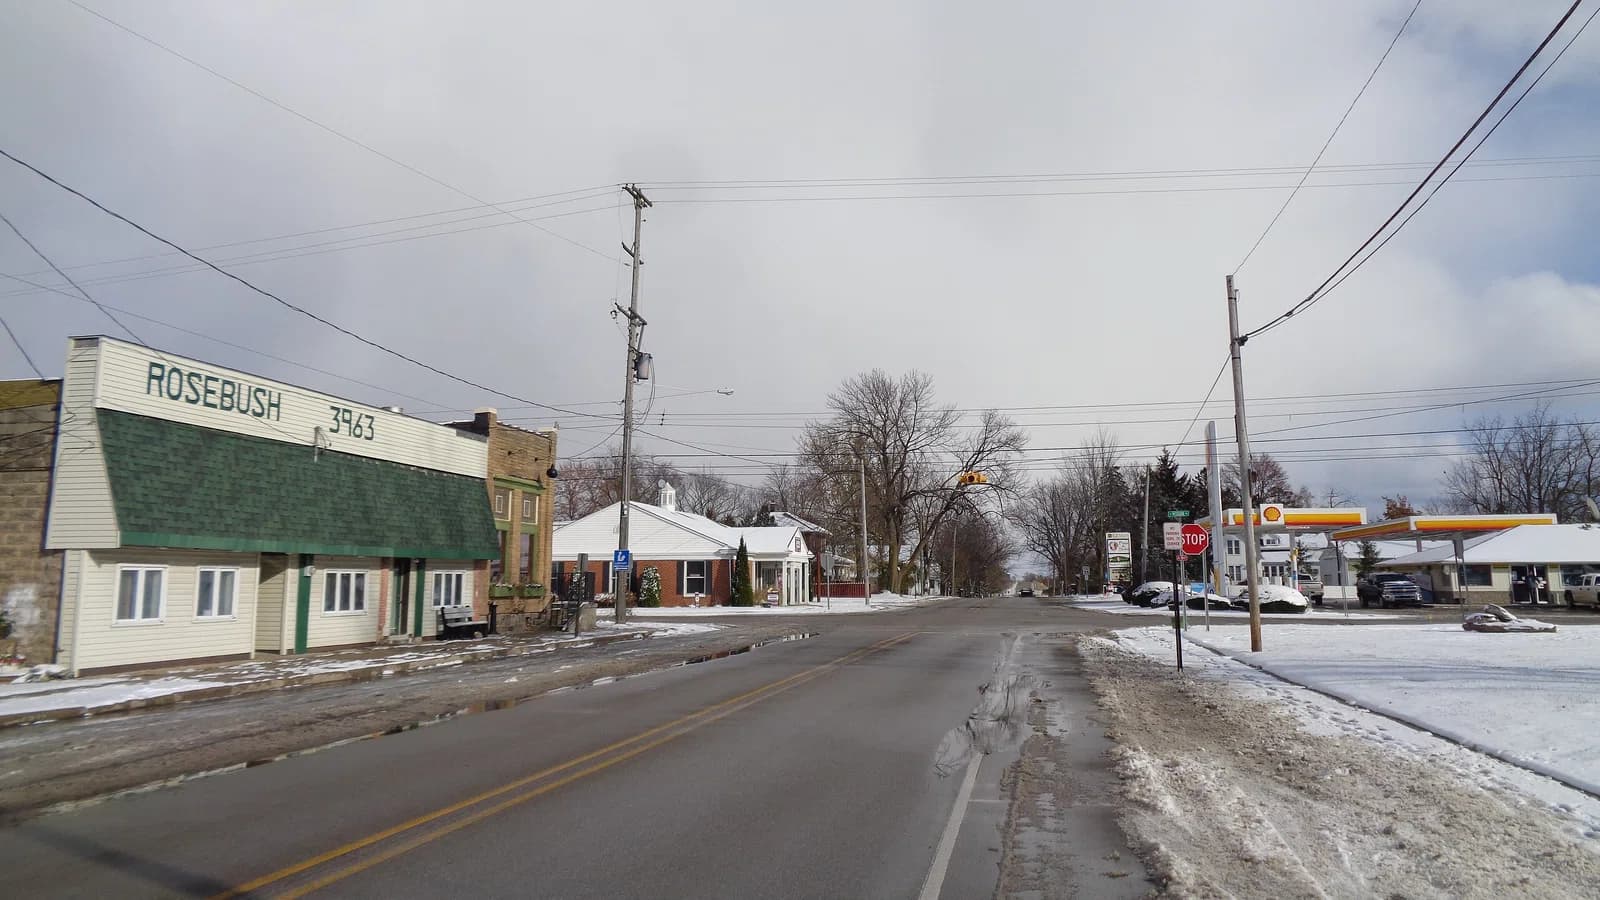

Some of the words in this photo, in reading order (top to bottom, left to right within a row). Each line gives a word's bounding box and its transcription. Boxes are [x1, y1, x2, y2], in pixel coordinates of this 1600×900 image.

[146, 361, 282, 422] ROSEBUSH
[329, 405, 375, 441] 3963
[1181, 533, 1206, 545] STOP
